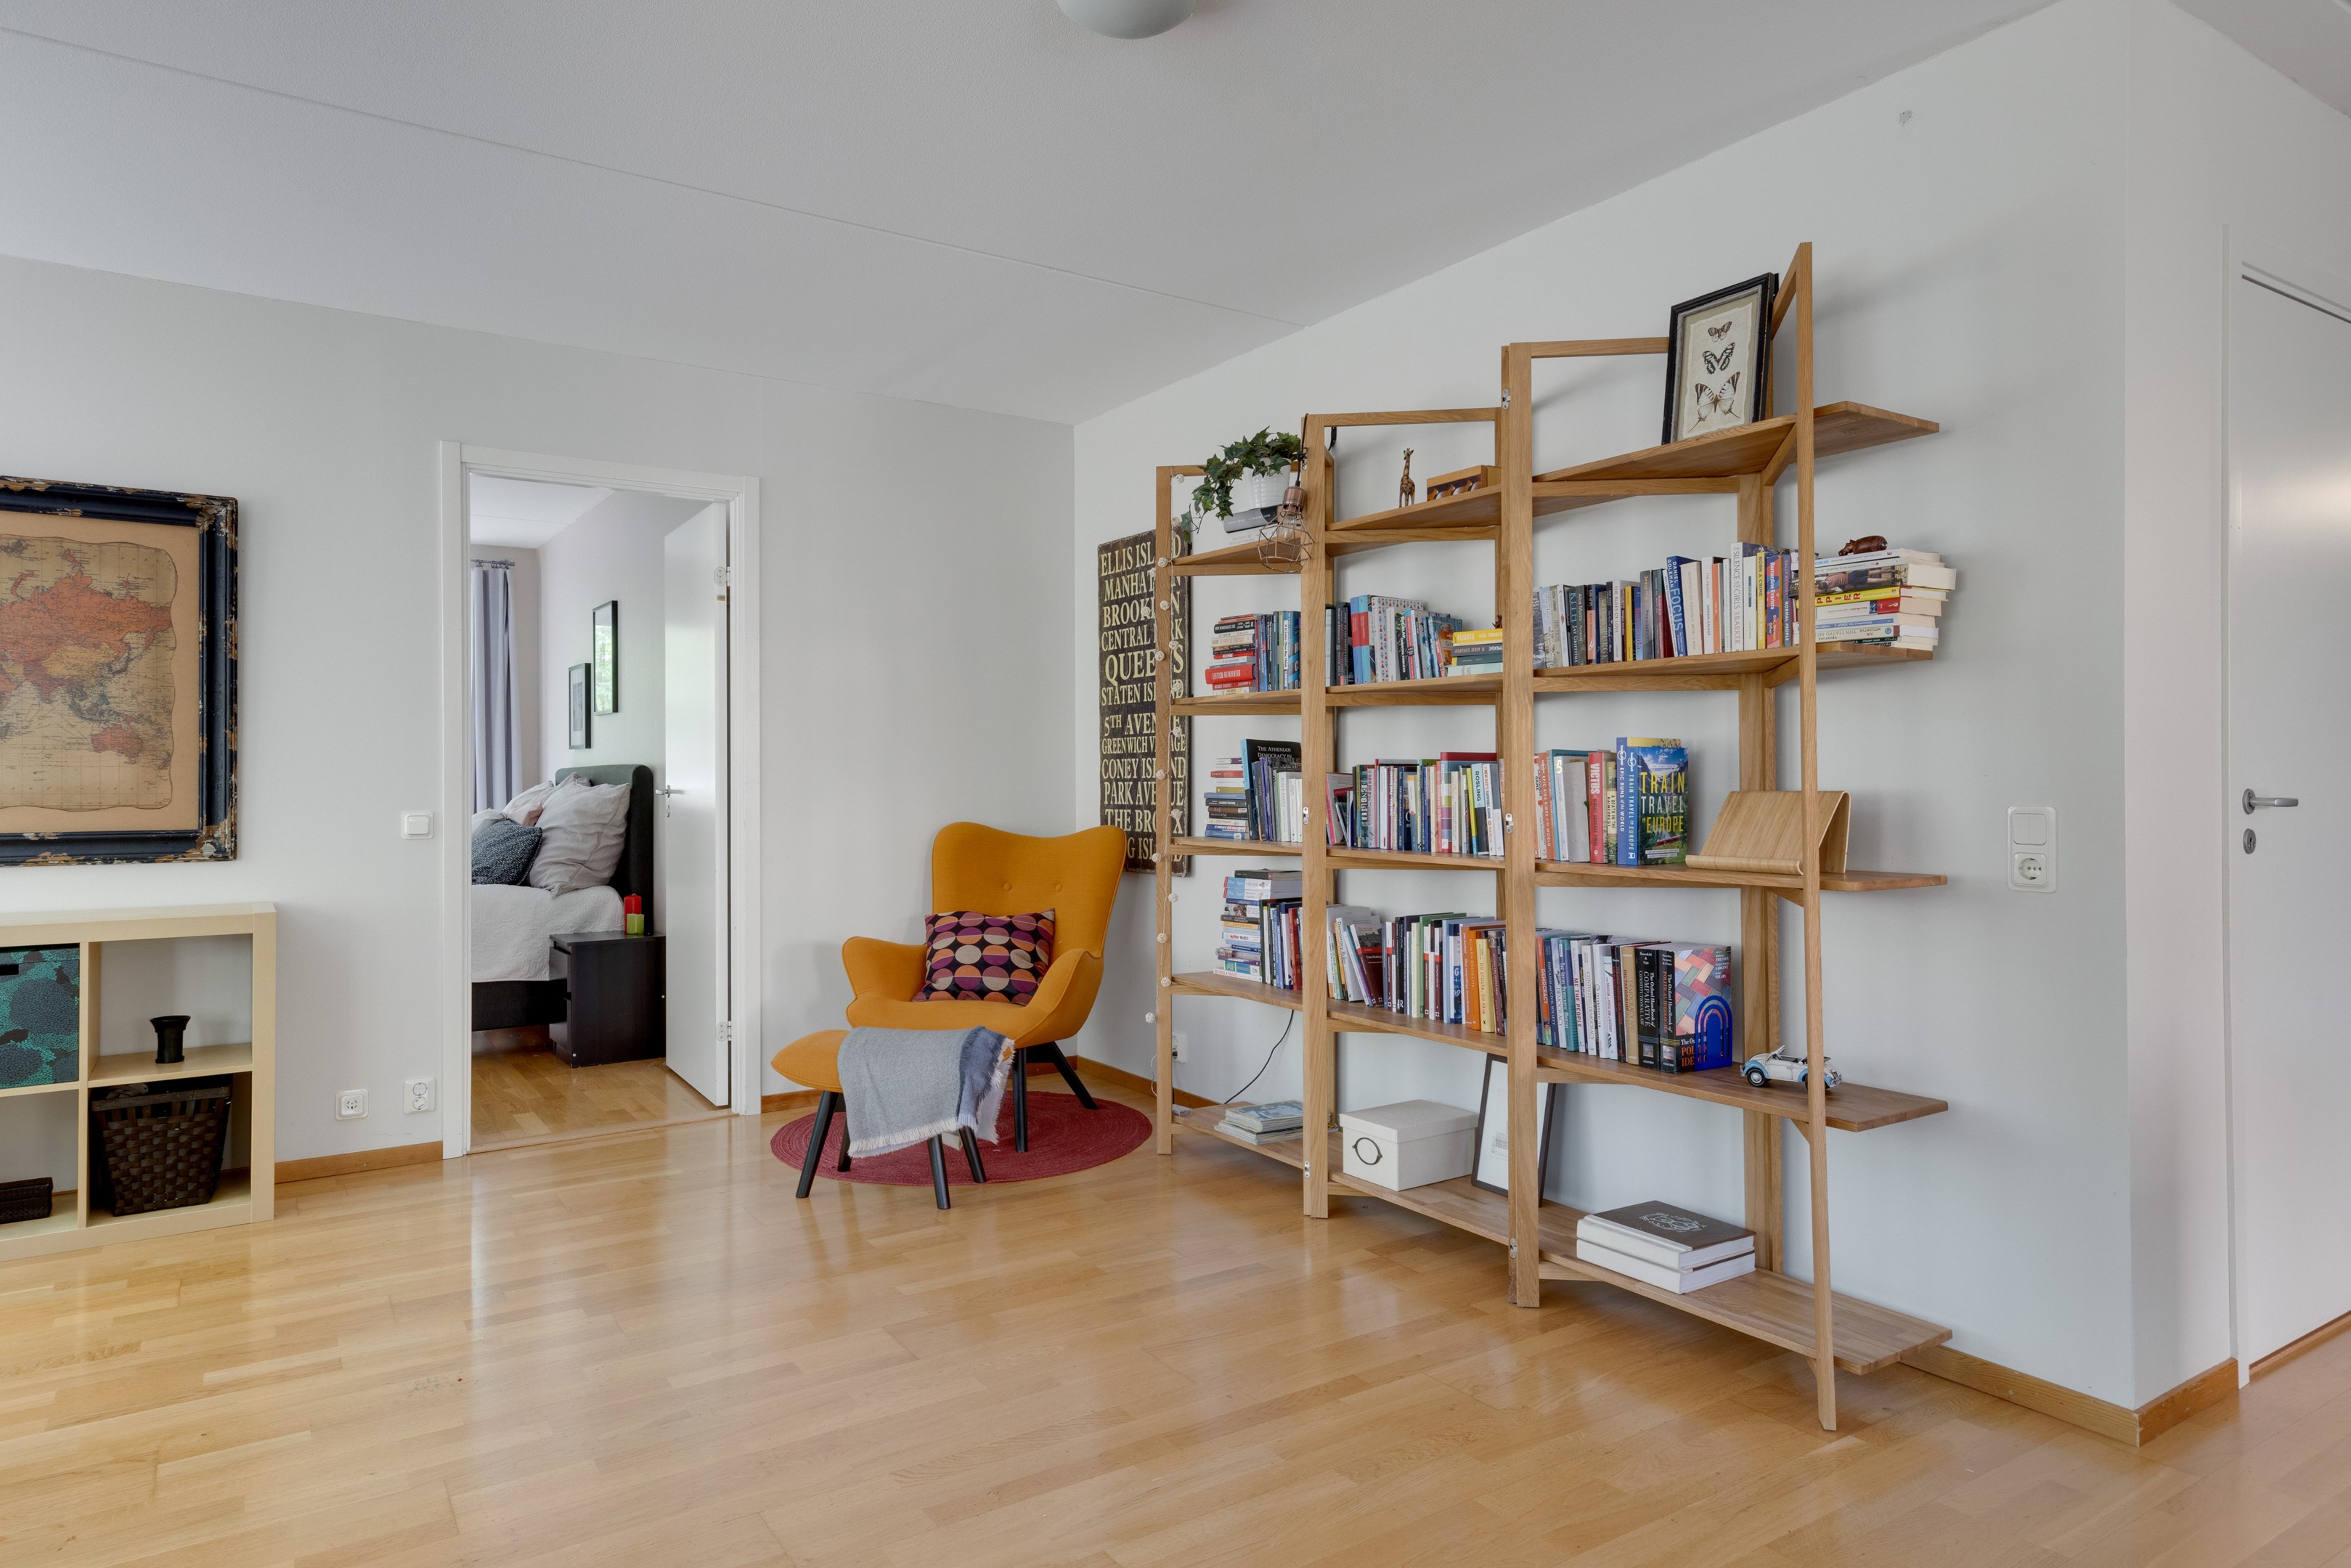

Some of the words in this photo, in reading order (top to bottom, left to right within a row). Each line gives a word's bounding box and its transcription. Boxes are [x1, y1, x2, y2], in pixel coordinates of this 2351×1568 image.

[1101, 546, 1133, 576] ELLIS
[1136, 534, 1181, 567] ISLD
[1104, 570, 1181, 602] MANHAT
[1103, 592, 1181, 628] BROOKLN
[1670, 588, 1683, 631] FOCUS
[1101, 624, 1151, 652] CENTRAL
[1105, 645, 1184, 687] QUEES
[1101, 683, 1141, 706] STATEN
[1144, 679, 1184, 702] ISD
[1104, 715, 1122, 737] 5TH
[1125, 711, 1181, 735] AVEE
[1101, 735, 1148, 754] GREENWICH
[1149, 733, 1186, 752] VAGE
[1101, 758, 1138, 780] CONEY
[1142, 757, 1186, 779] ISLND
[1555, 759, 1562, 774] 50
[1590, 763, 1600, 794] VICTUS
[1104, 782, 1133, 805] PARK
[1136, 782, 1183, 806] AVEUE
[1641, 772, 1685, 793] TRAIN
[1641, 796, 1684, 814] TRAVEL
[1105, 809, 1131, 832] THE
[1135, 809, 1183, 834] BRX
[1646, 816, 1684, 833] EUROPE
[1574, 978, 1578, 987] ME
